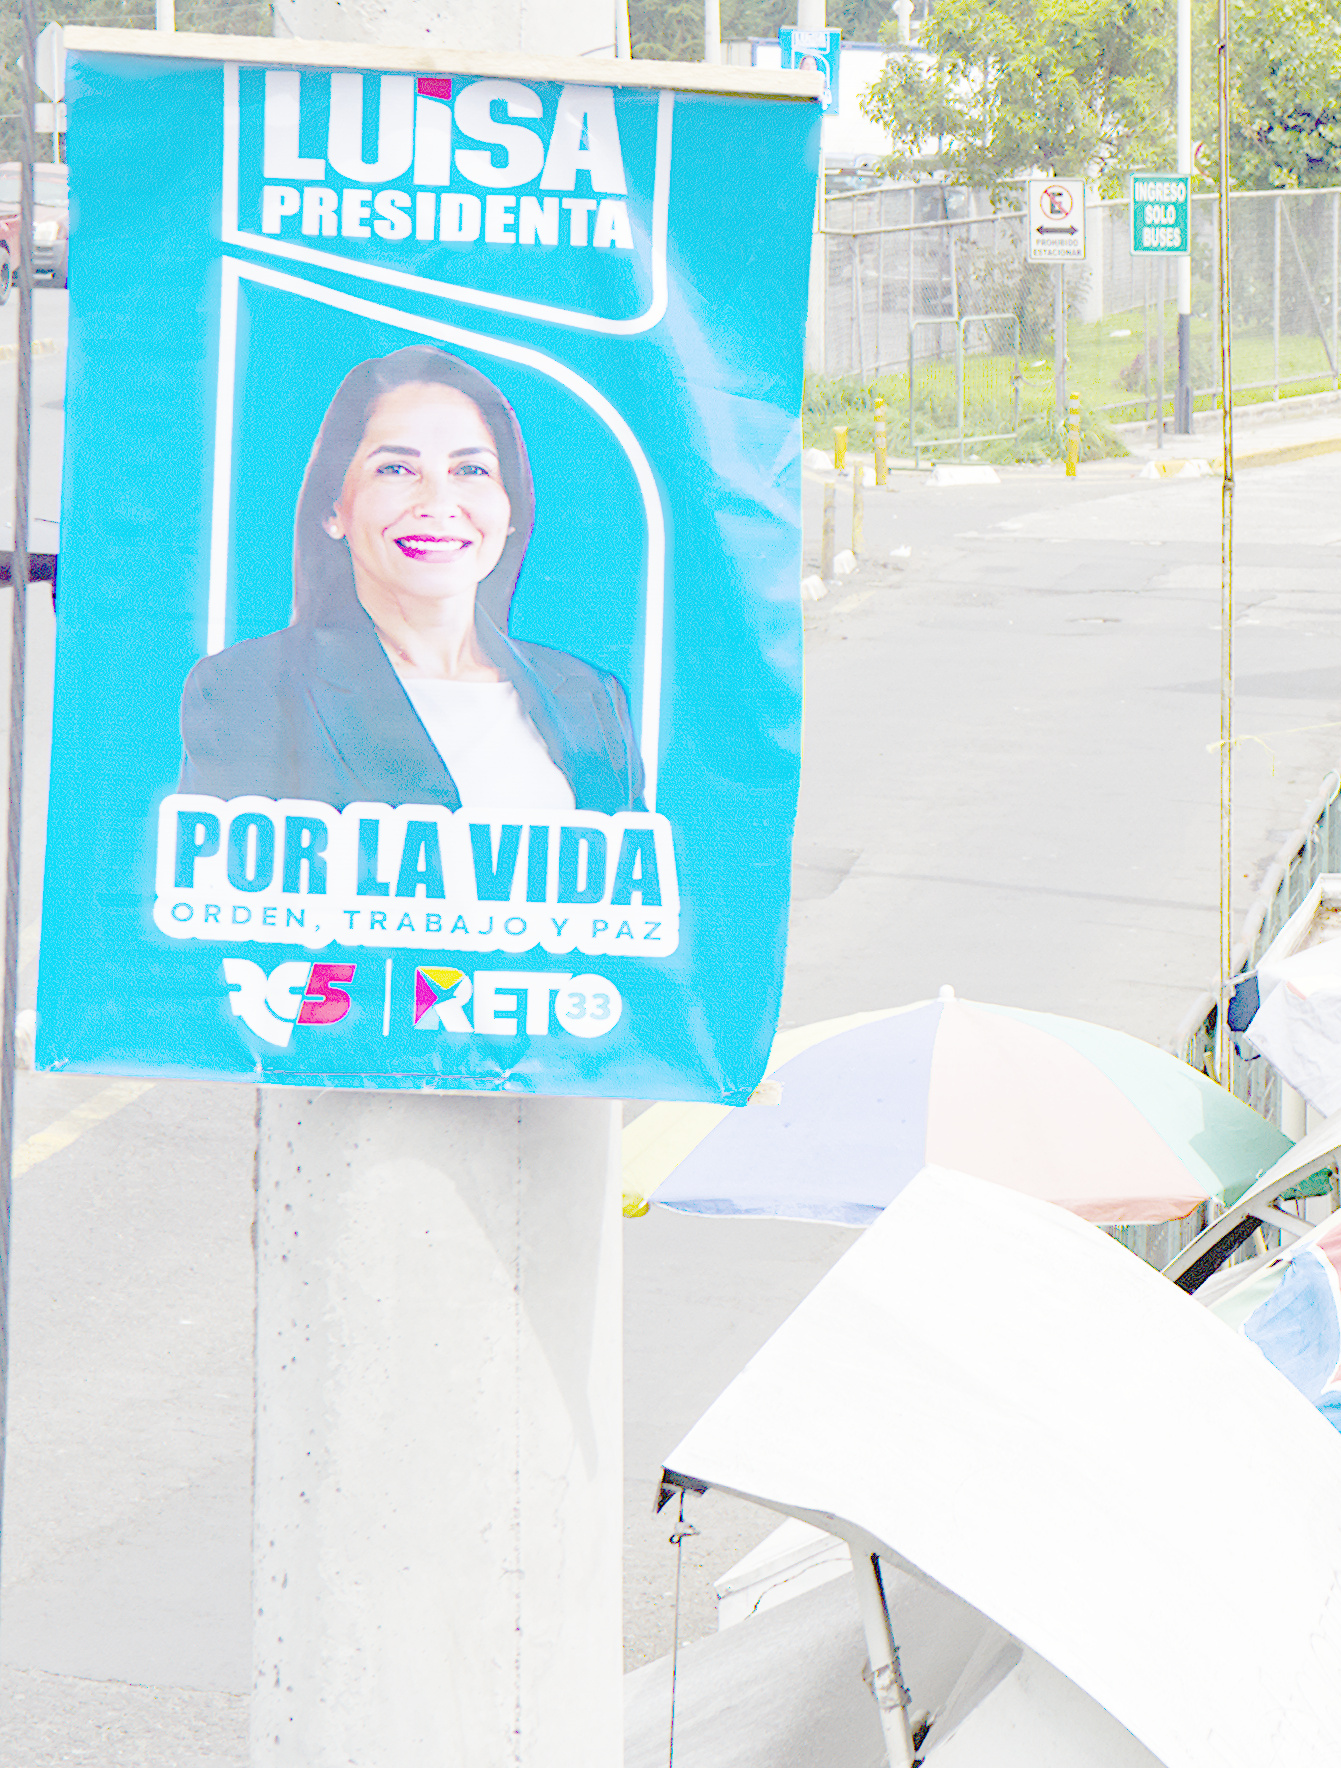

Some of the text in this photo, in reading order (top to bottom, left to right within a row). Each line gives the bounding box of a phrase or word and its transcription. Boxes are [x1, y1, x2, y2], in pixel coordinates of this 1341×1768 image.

[1134, 181, 1187, 202] INGRESO
[261, 185, 634, 249] PRESIDENTA
[1144, 204, 1176, 225] SOLO
[1142, 226, 1182, 248] BUSES
[173, 809, 663, 907] POR LA VIDA
[170, 902, 662, 941] ORDEN, TRABAJO Y PAZ
[566, 991, 611, 1020] 33
